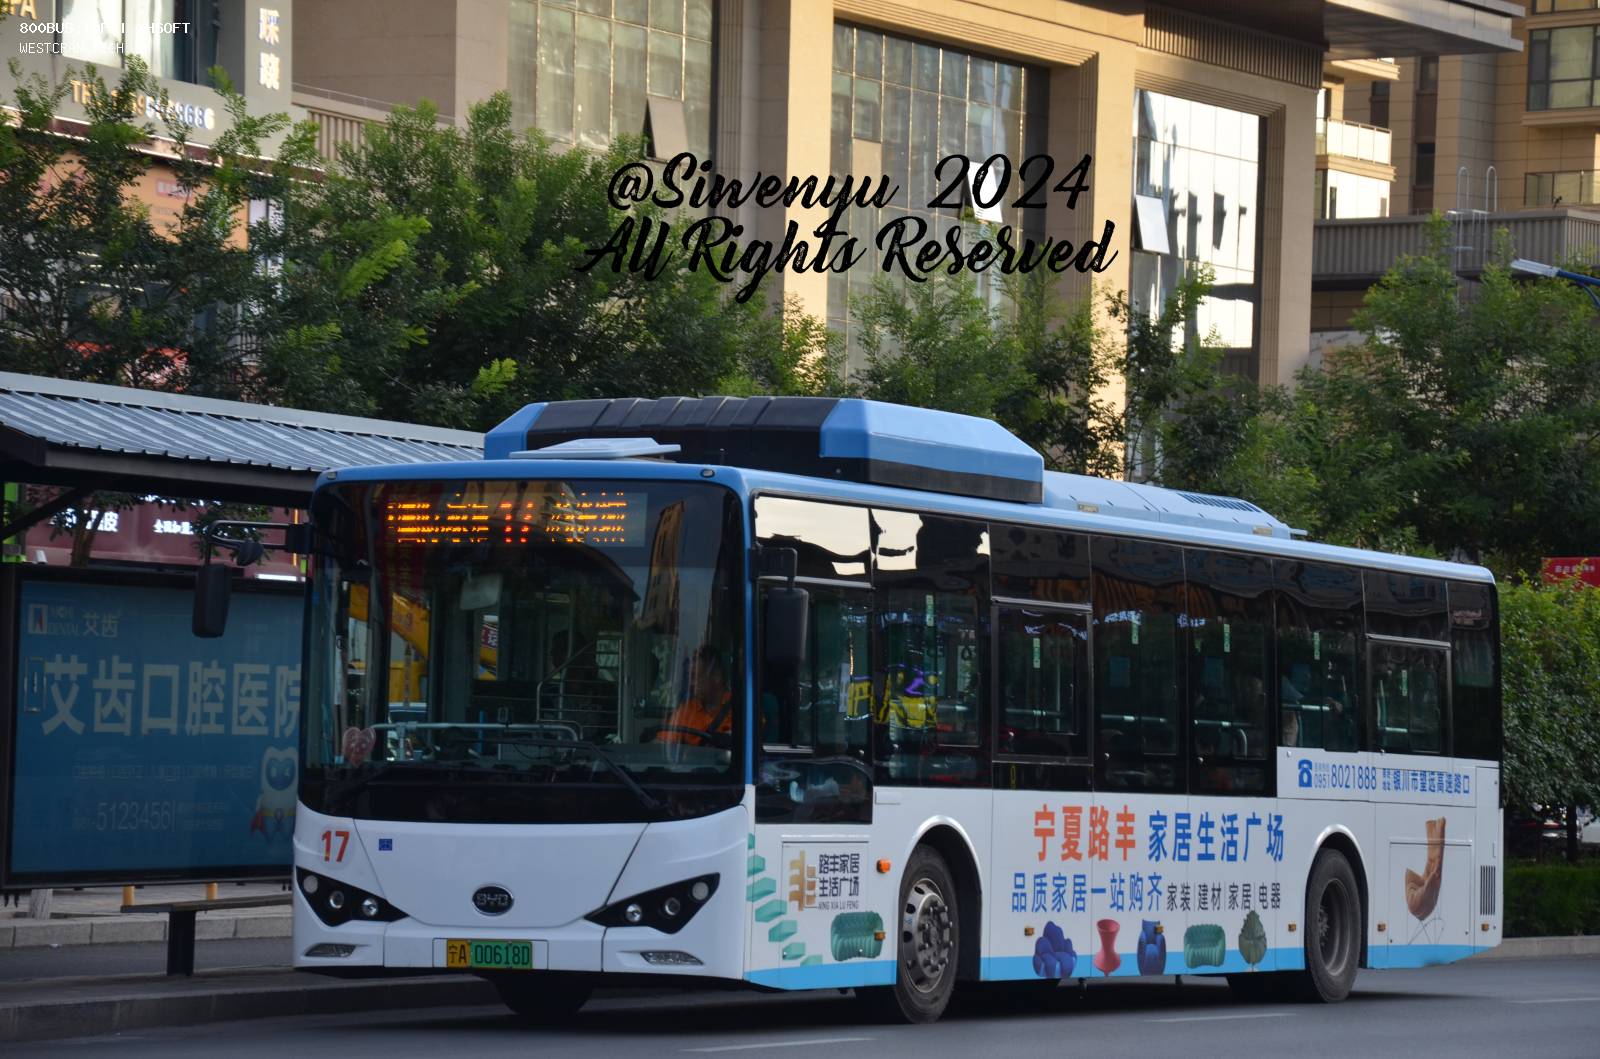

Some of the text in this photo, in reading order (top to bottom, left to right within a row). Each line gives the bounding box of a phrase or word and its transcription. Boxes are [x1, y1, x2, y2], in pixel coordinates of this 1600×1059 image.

[82, 609, 119, 638] 艾齿
[41, 654, 301, 738] 艾齿口腔医院
[1331, 764, 1377, 790] 8021888
[96, 801, 170, 831] 5123456
[321, 830, 350, 862] 17
[1034, 804, 1284, 862] 宁夏路丰 家居生活广场
[819, 853, 860, 874] 路丰家居
[476, 893, 508, 907] BYD
[819, 876, 860, 897] 生活广场
[1011, 872, 1163, 913] 品质家居一站购齐
